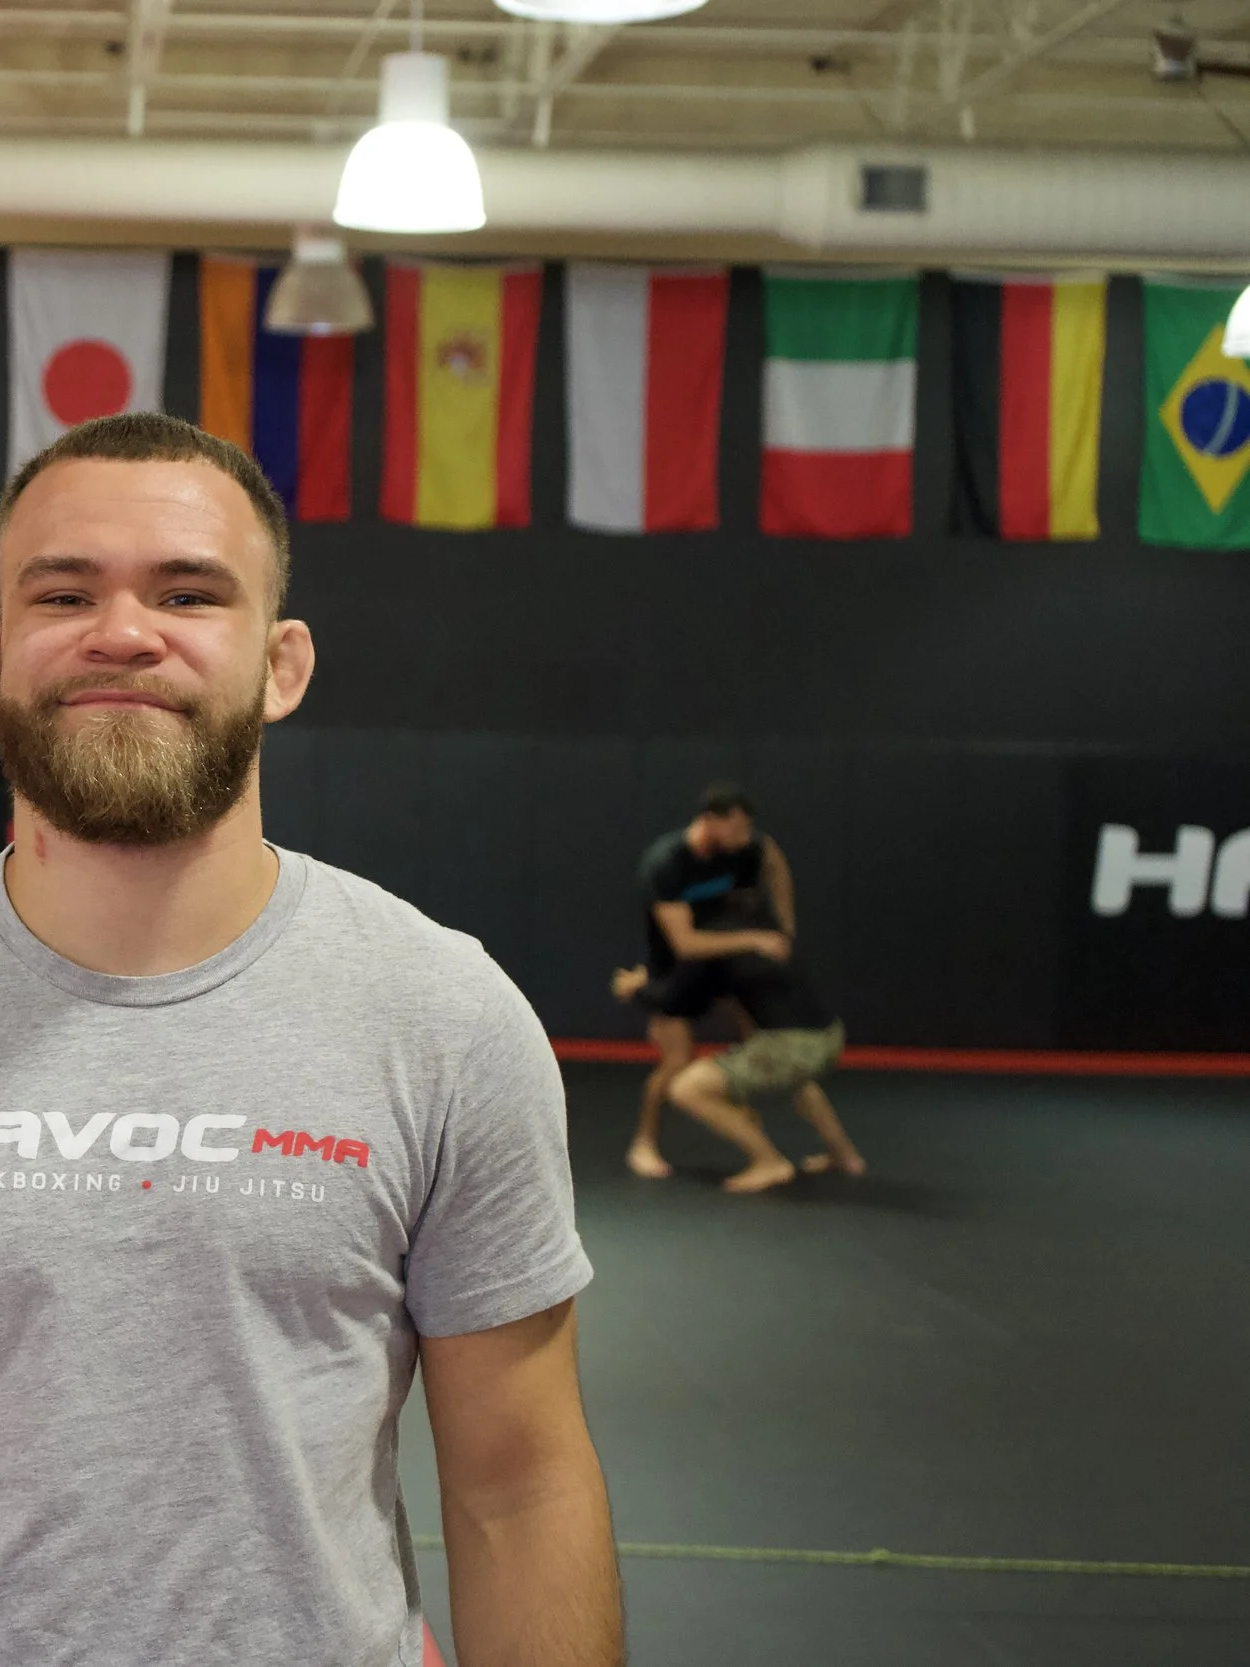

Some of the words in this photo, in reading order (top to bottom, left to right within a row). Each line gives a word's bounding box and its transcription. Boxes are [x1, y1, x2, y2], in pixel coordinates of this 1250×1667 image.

[252, 1128, 370, 1168] MMA
[172, 1175, 220, 1193] JIU
[239, 1178, 326, 1202] JITSU
